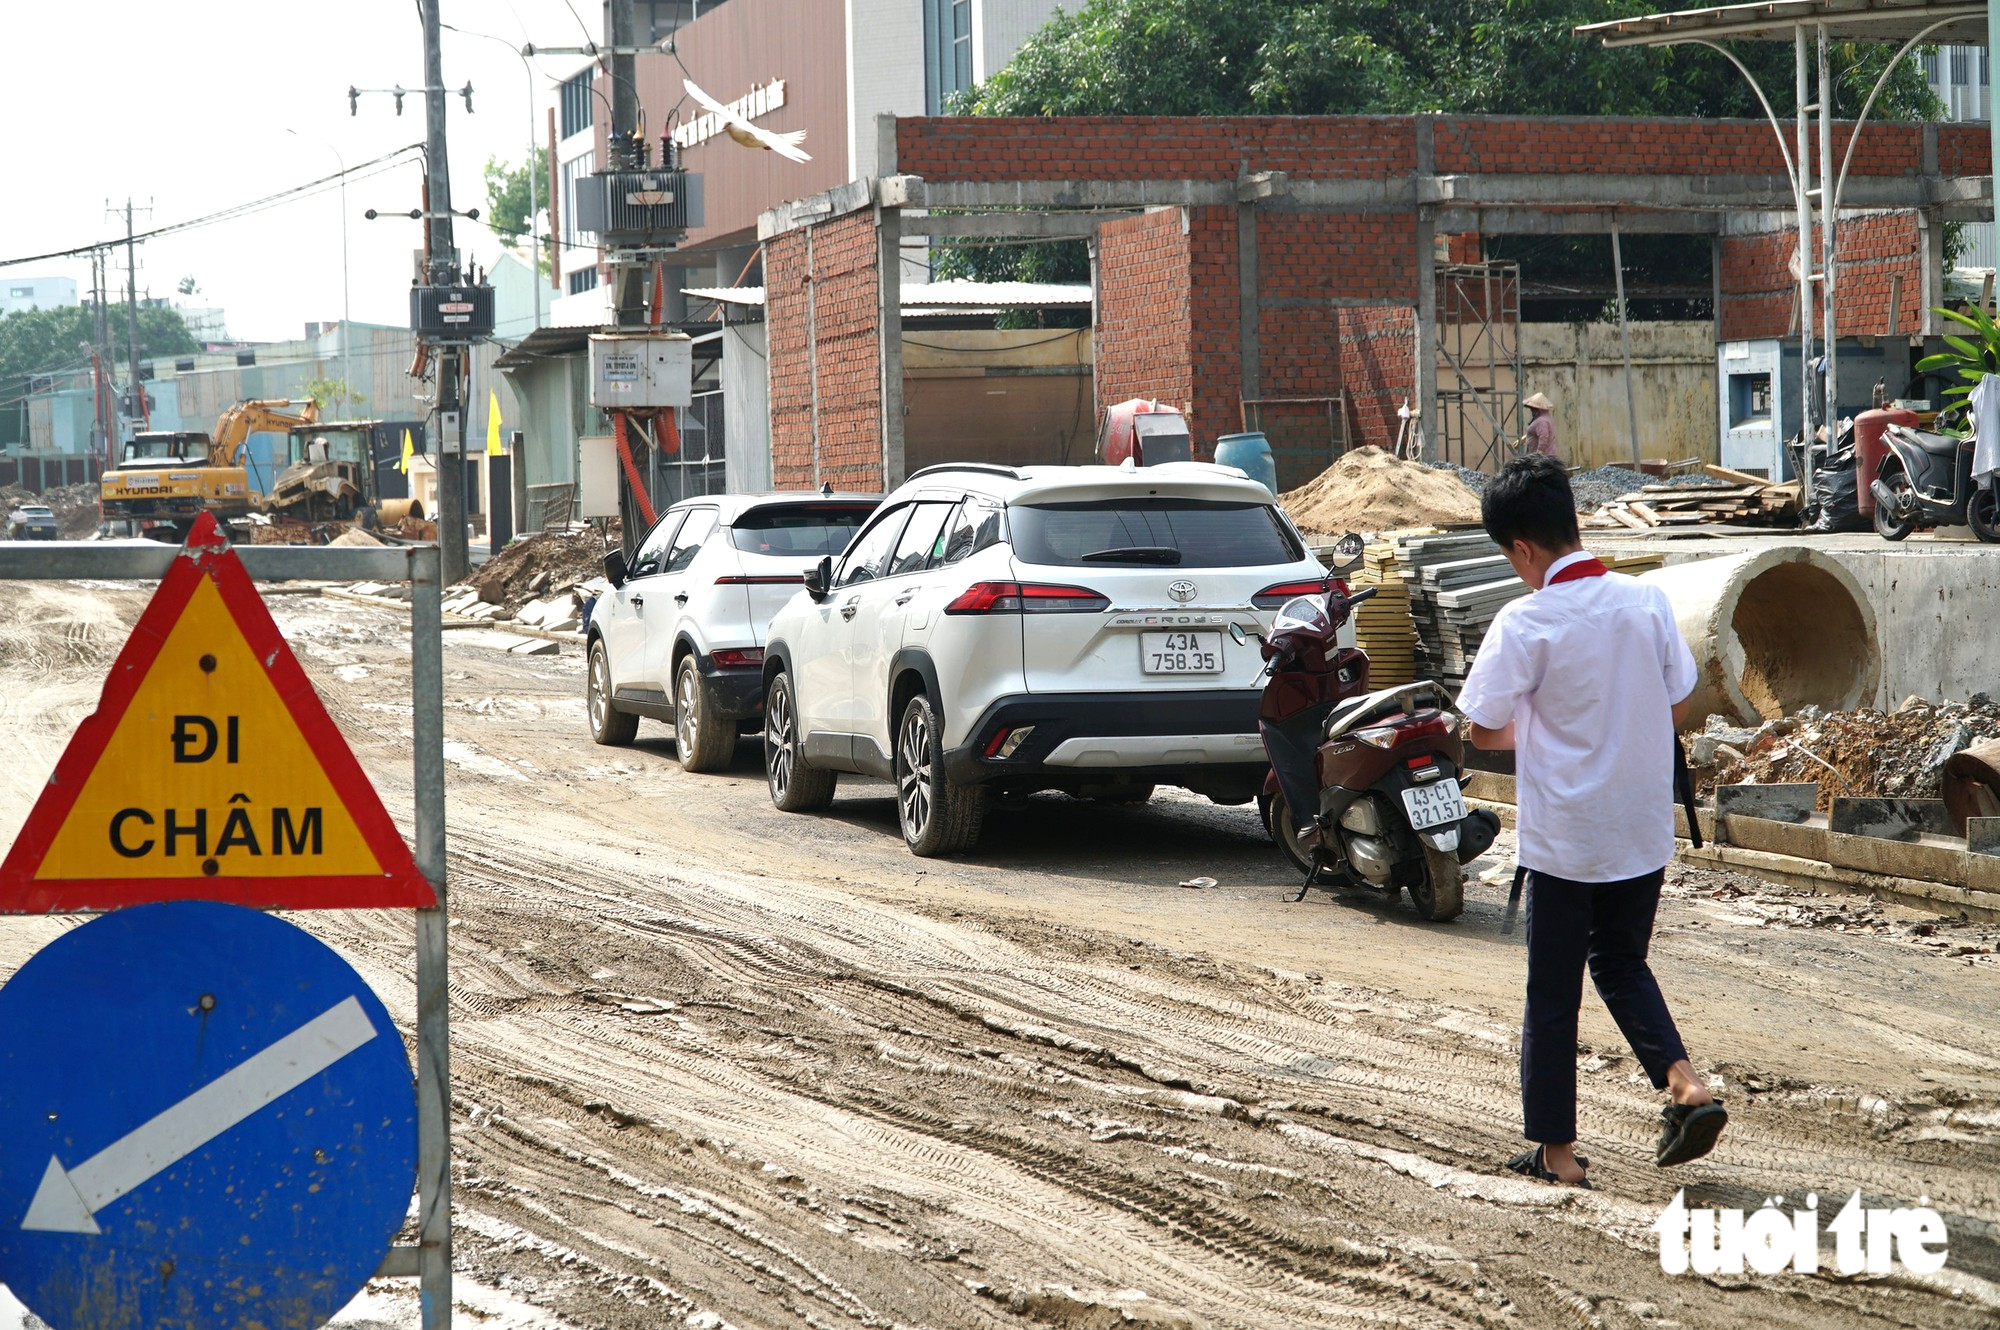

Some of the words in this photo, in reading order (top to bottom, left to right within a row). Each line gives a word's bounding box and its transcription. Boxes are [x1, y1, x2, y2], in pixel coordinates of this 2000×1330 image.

[116, 486, 173, 495] HYUNDAI
[1145, 615, 1222, 624] CROSS
[1165, 633, 1200, 651] 43A
[1152, 652, 1215, 671] 758.35
[171, 715, 239, 764] ĐI
[1412, 783, 1452, 807] 43-C1
[1412, 800, 1462, 827] 321.57
